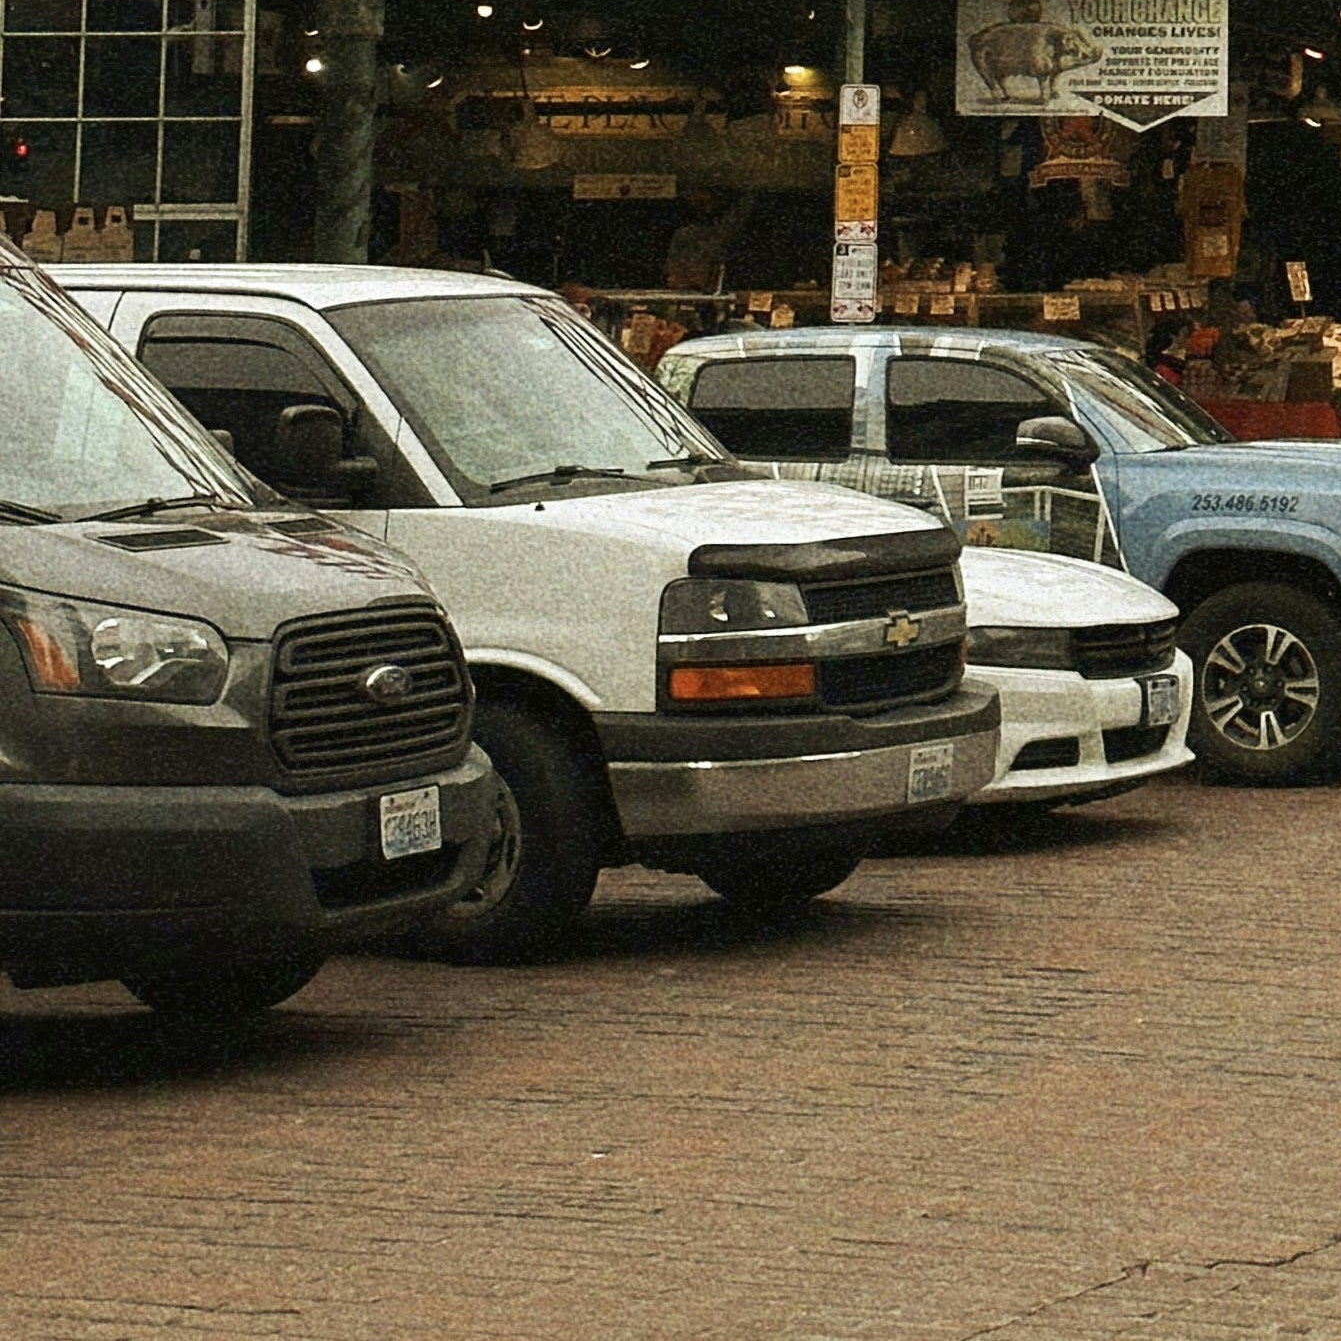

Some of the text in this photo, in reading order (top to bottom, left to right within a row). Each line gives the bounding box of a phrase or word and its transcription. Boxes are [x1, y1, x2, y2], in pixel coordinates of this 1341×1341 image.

[1093, 26, 1167, 38] CHANGES
[1110, 46, 1143, 55] YOUR
[1094, 94, 1150, 106] DONATE
[1191, 494, 1300, 514] 253.486.5192
